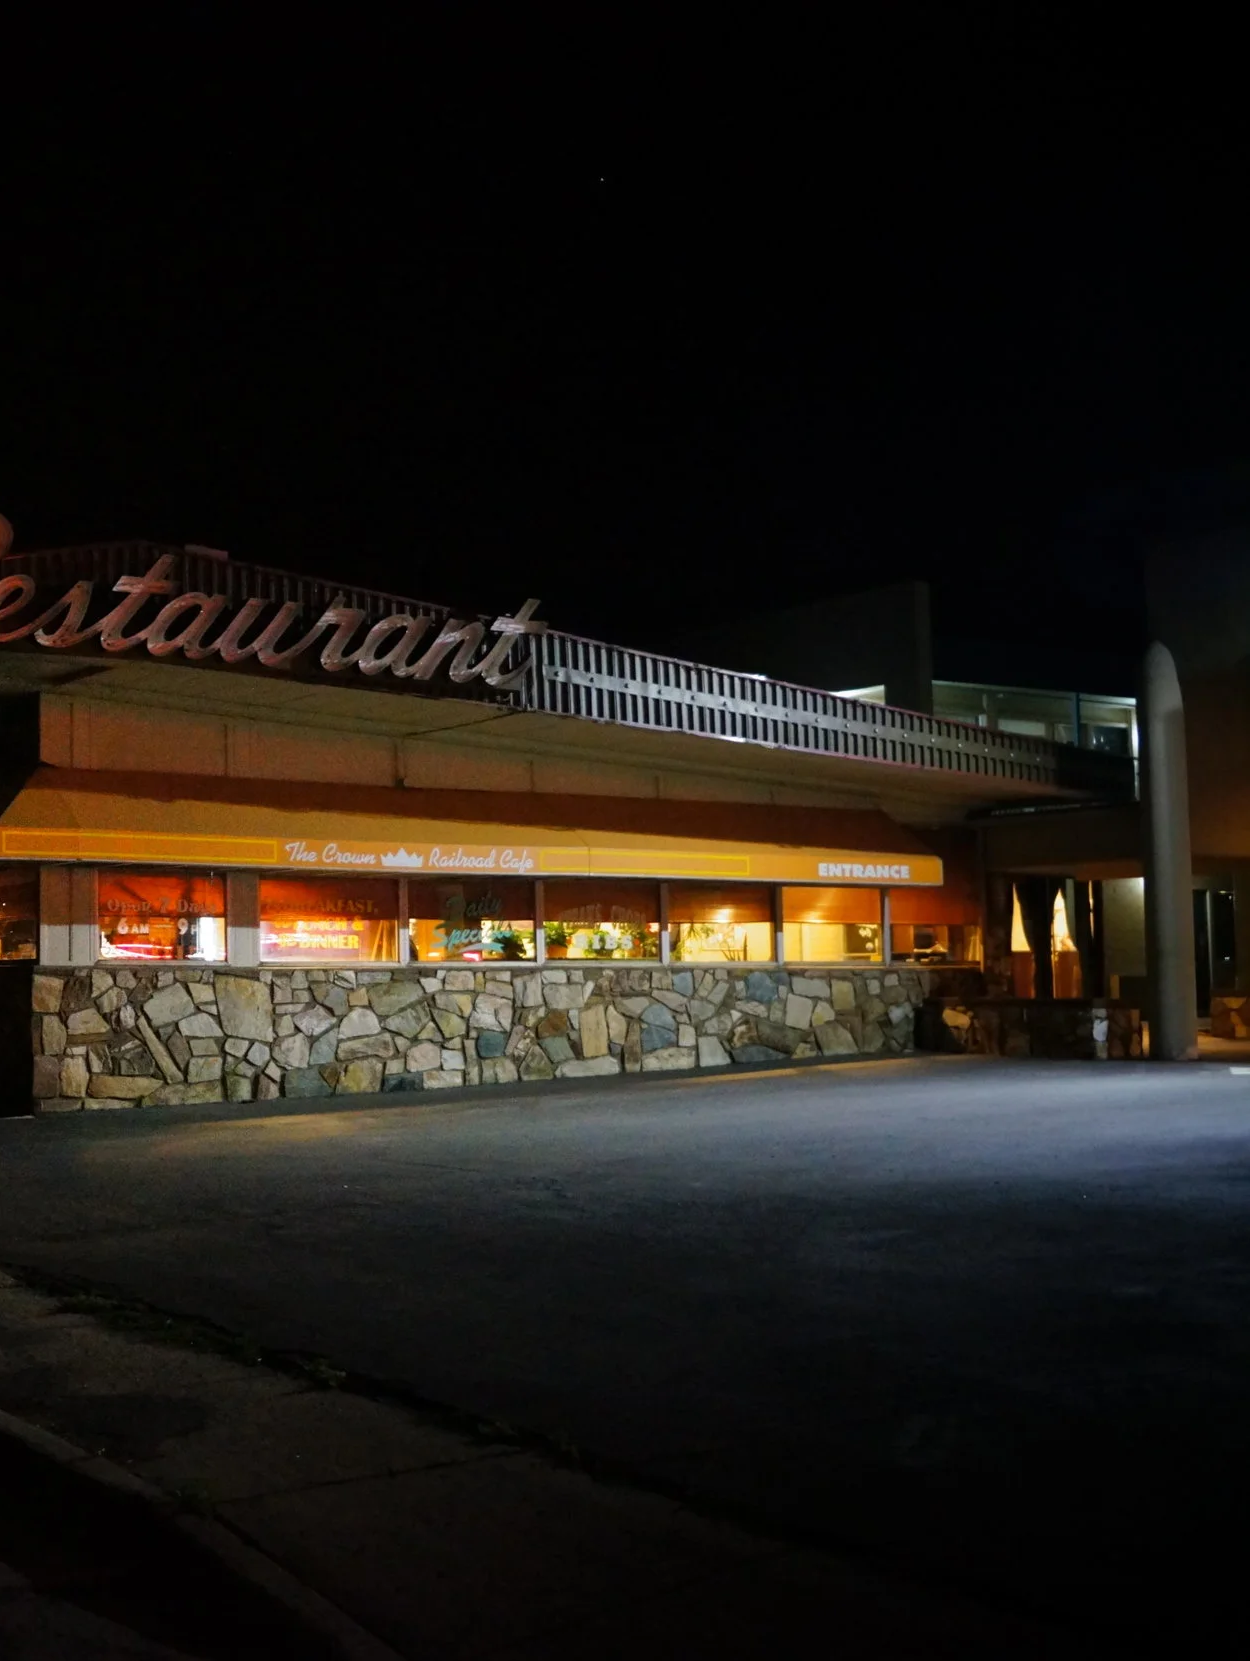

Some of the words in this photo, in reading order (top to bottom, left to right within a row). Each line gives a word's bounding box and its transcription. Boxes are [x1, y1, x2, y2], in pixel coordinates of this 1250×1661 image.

[285, 842, 318, 862] The
[321, 843, 376, 864] Crown
[428, 848, 496, 868] Railroad
[499, 850, 534, 873] Cafe
[818, 863, 910, 878] ENTRANCE
[117, 917, 129, 935] 6
[131, 923, 150, 934] AM
[177, 918, 188, 935] 9
